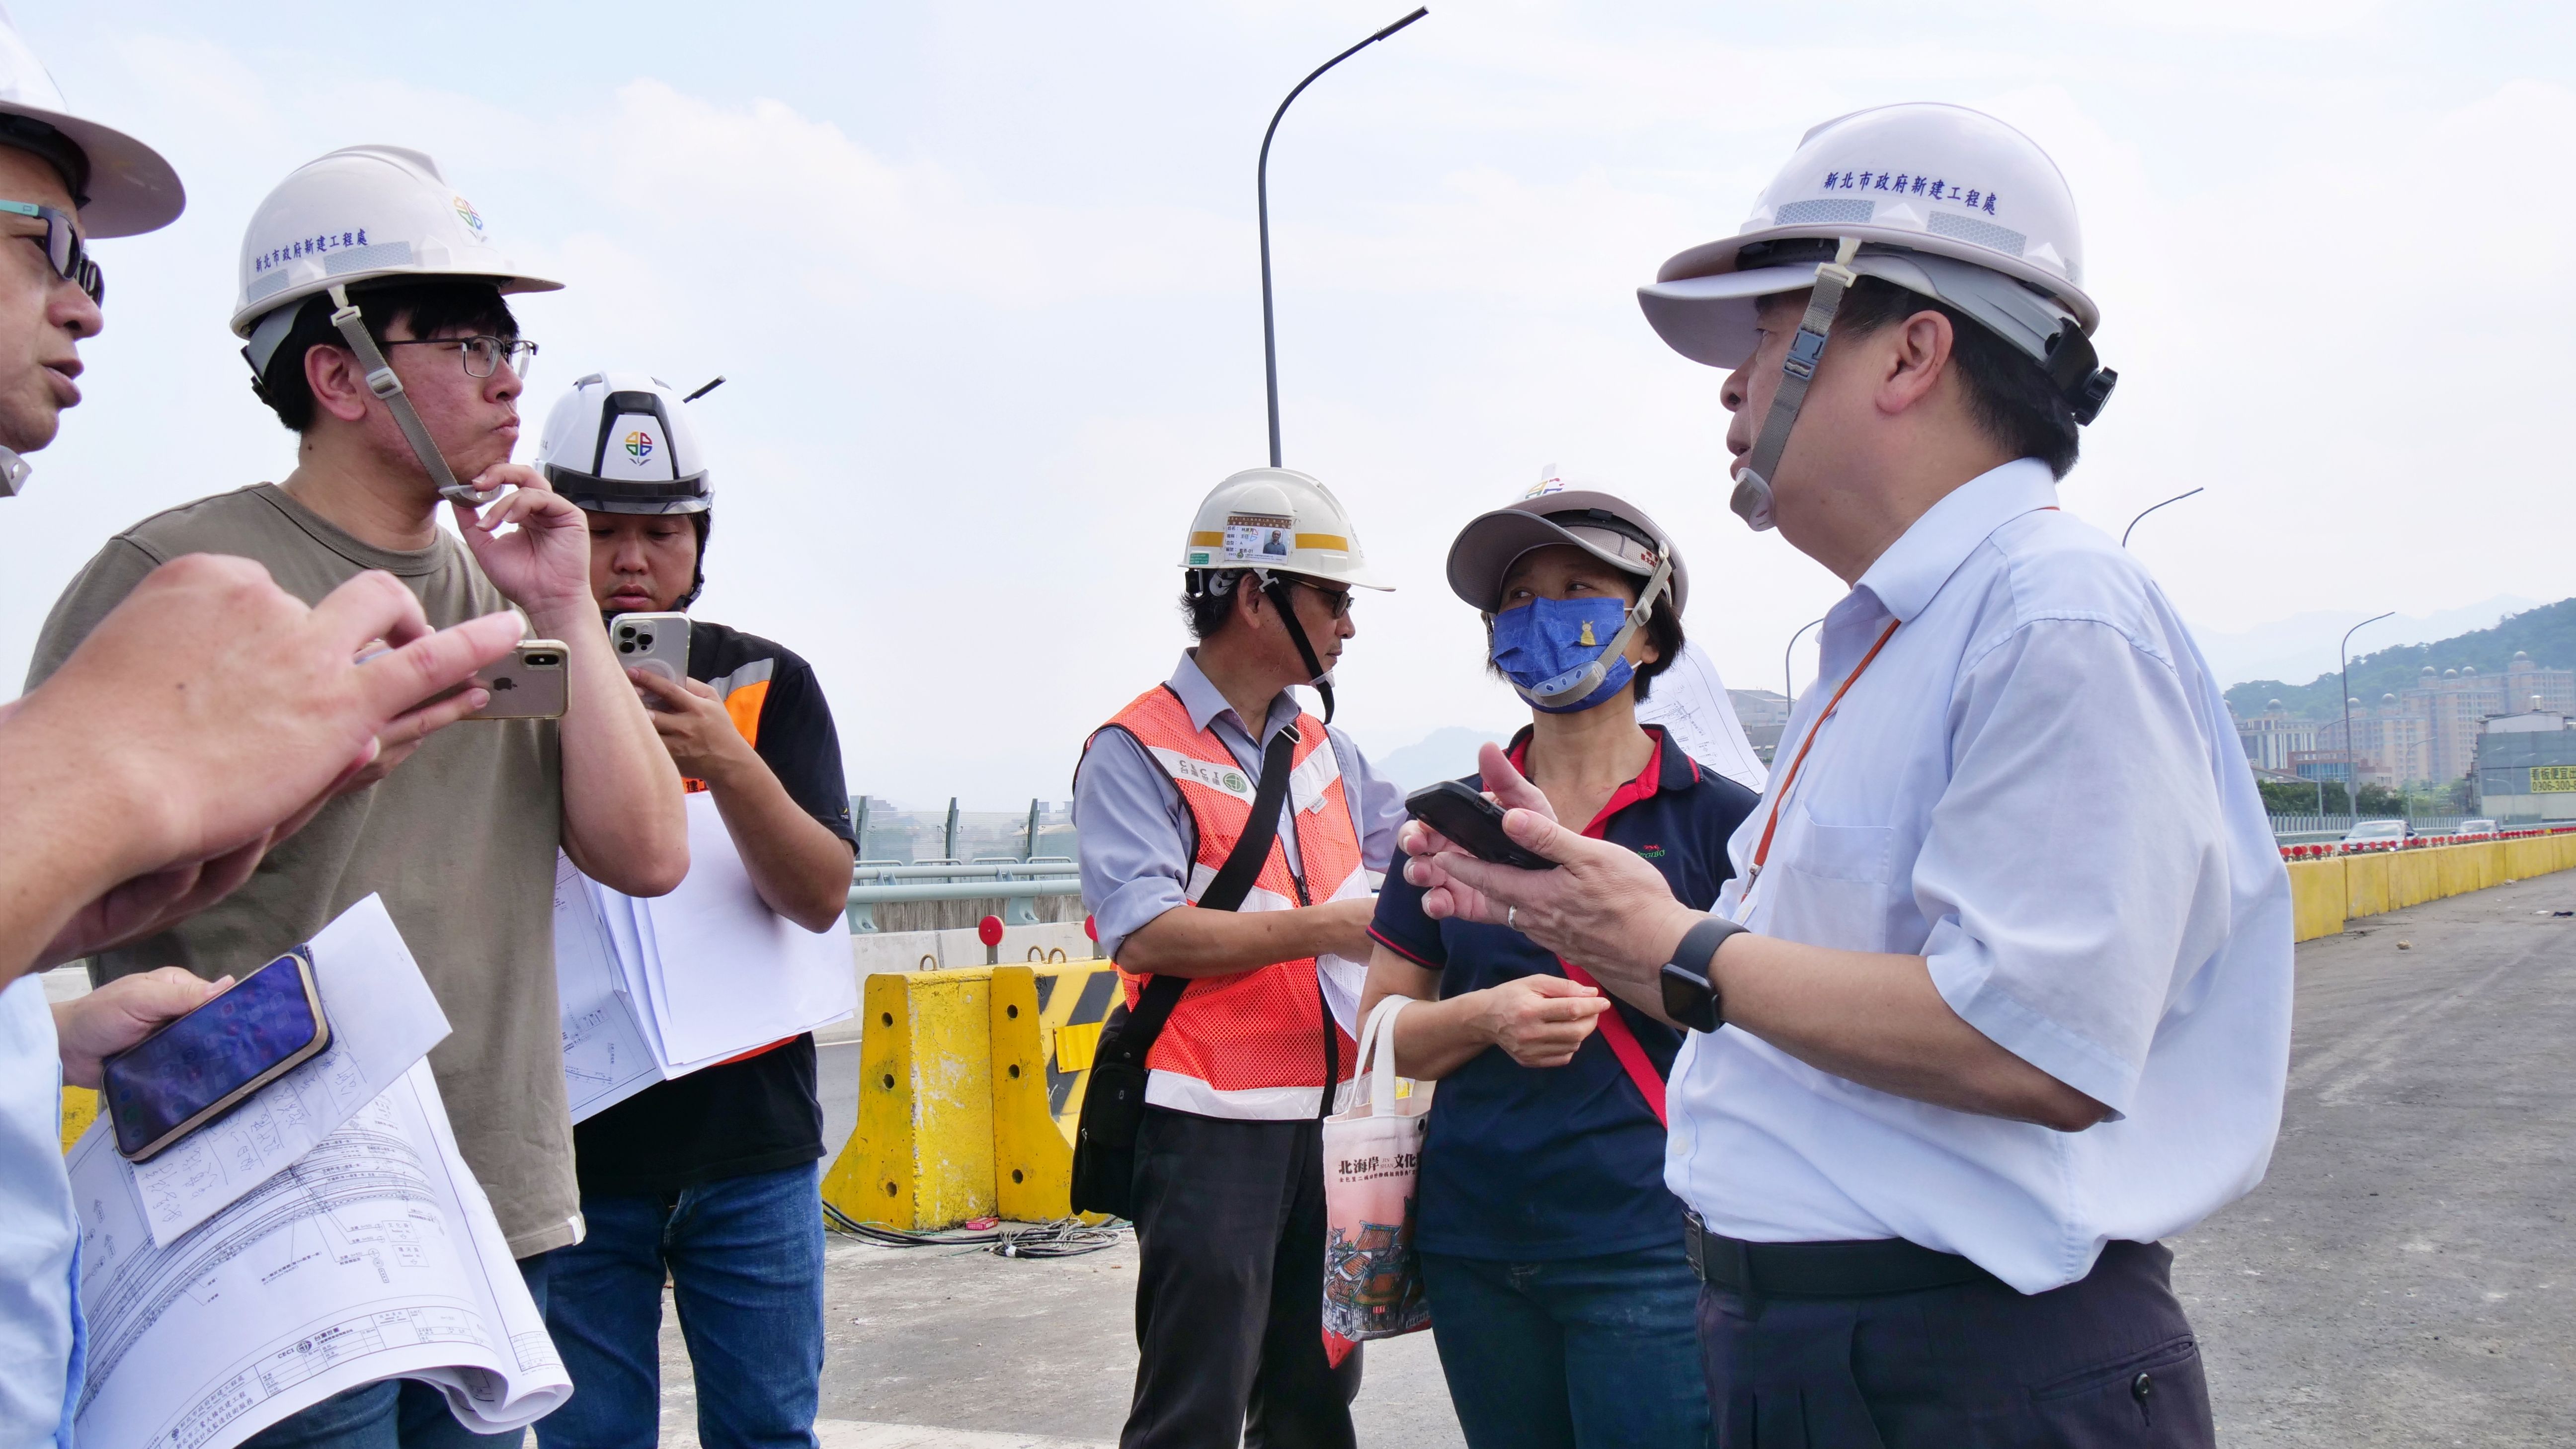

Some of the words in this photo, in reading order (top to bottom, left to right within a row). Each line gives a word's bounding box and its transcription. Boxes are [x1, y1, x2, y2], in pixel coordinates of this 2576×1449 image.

[1824, 171, 1997, 216] 新北市政府新建工程處
[255, 228, 369, 273] 新北市政府新建工程處
[1339, 1156, 1379, 1175] 北海岸
[277, 1348, 295, 1359] CECI
